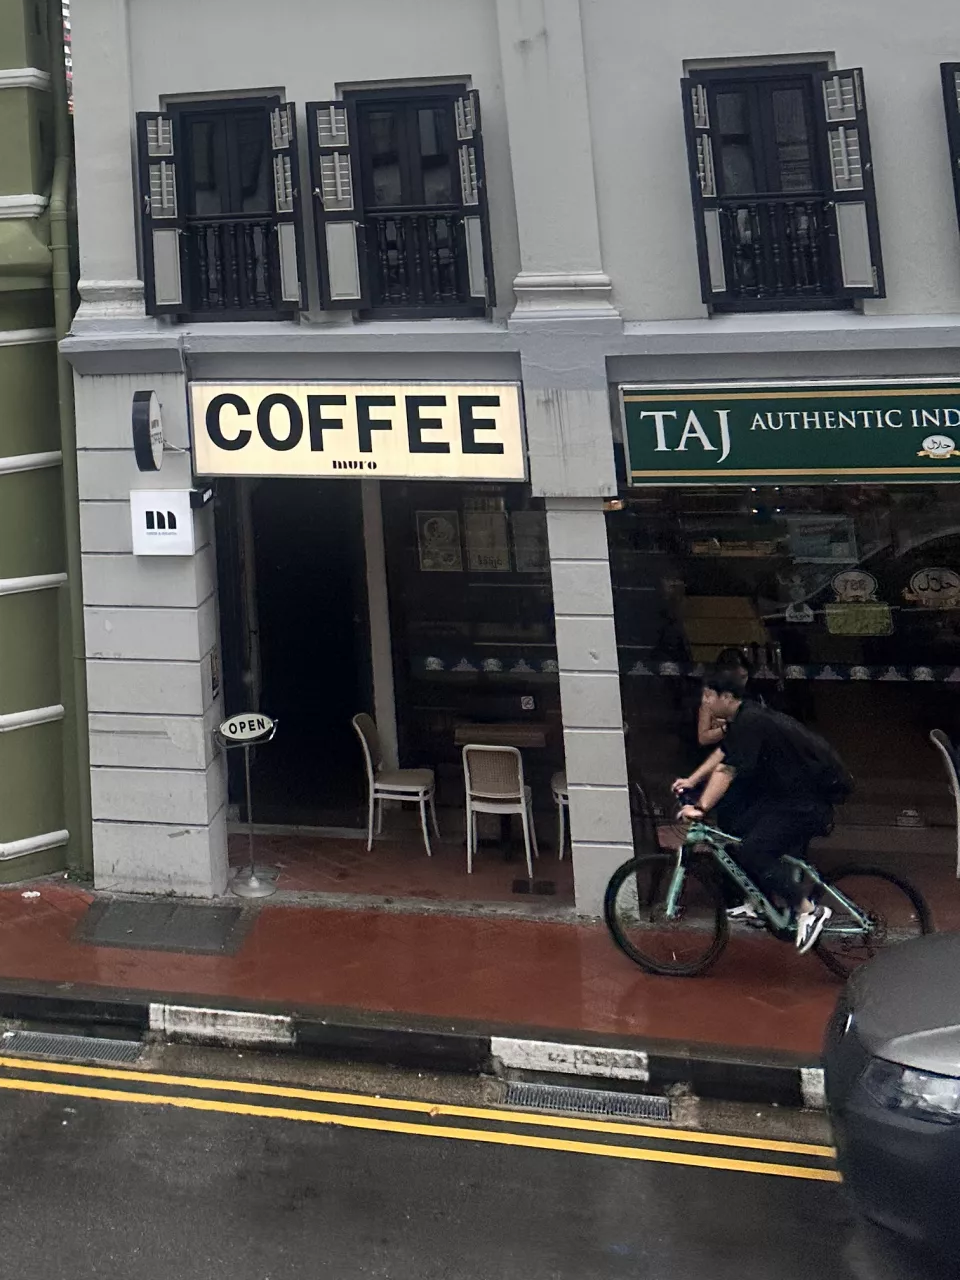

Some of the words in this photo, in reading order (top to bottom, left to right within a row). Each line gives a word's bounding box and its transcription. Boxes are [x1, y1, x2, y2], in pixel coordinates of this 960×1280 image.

[205, 392, 505, 455] COFFEE
[640, 408, 731, 464] TAJ
[750, 409, 903, 431] AUTHENTIC
[910, 408, 960, 427] IND
[332, 459, 378, 470] muro
[228, 718, 266, 735] OPEN
